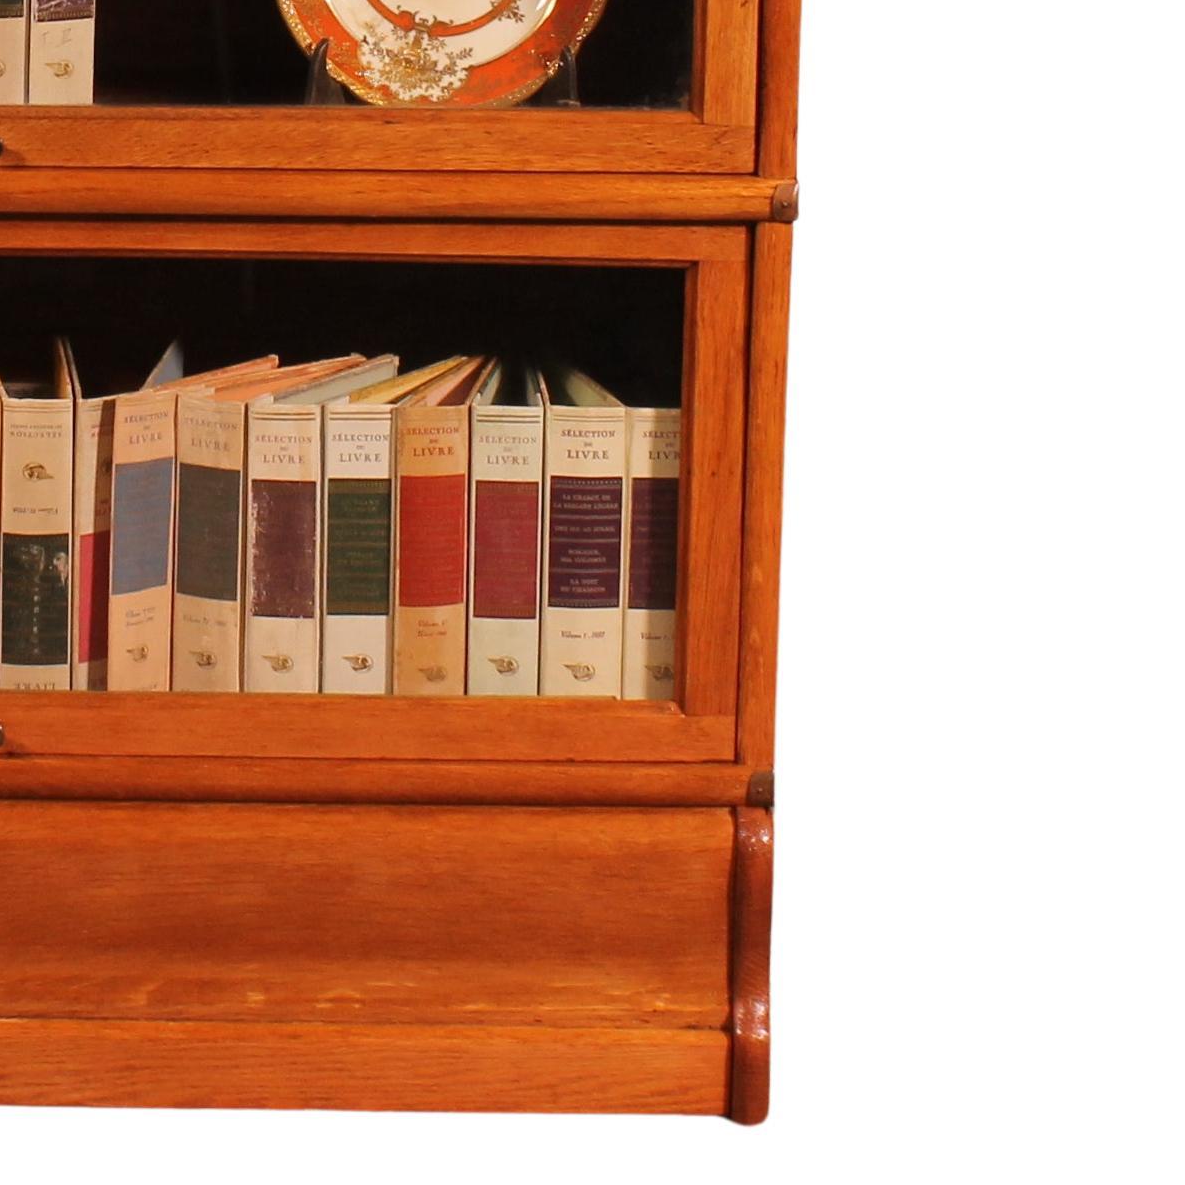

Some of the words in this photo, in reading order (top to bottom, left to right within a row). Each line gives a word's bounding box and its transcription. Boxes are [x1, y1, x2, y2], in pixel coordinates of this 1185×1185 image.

[331, 433, 389, 443] SÉLECTION
[560, 428, 616, 438] SÉLECTION
[642, 430, 681, 439] SÉLECT
[129, 433, 162, 445] LIVRE
[191, 438, 229, 452] LIVRE
[413, 445, 455, 457] LIVRE
[566, 449, 610, 460] LIVRE
[648, 450, 681, 461] LIVR
[262, 454, 305, 464] LIVRE
[340, 453, 383, 463] LIVRE
[486, 454, 530, 465] LIVRE
[560, 630, 582, 639] Volume
